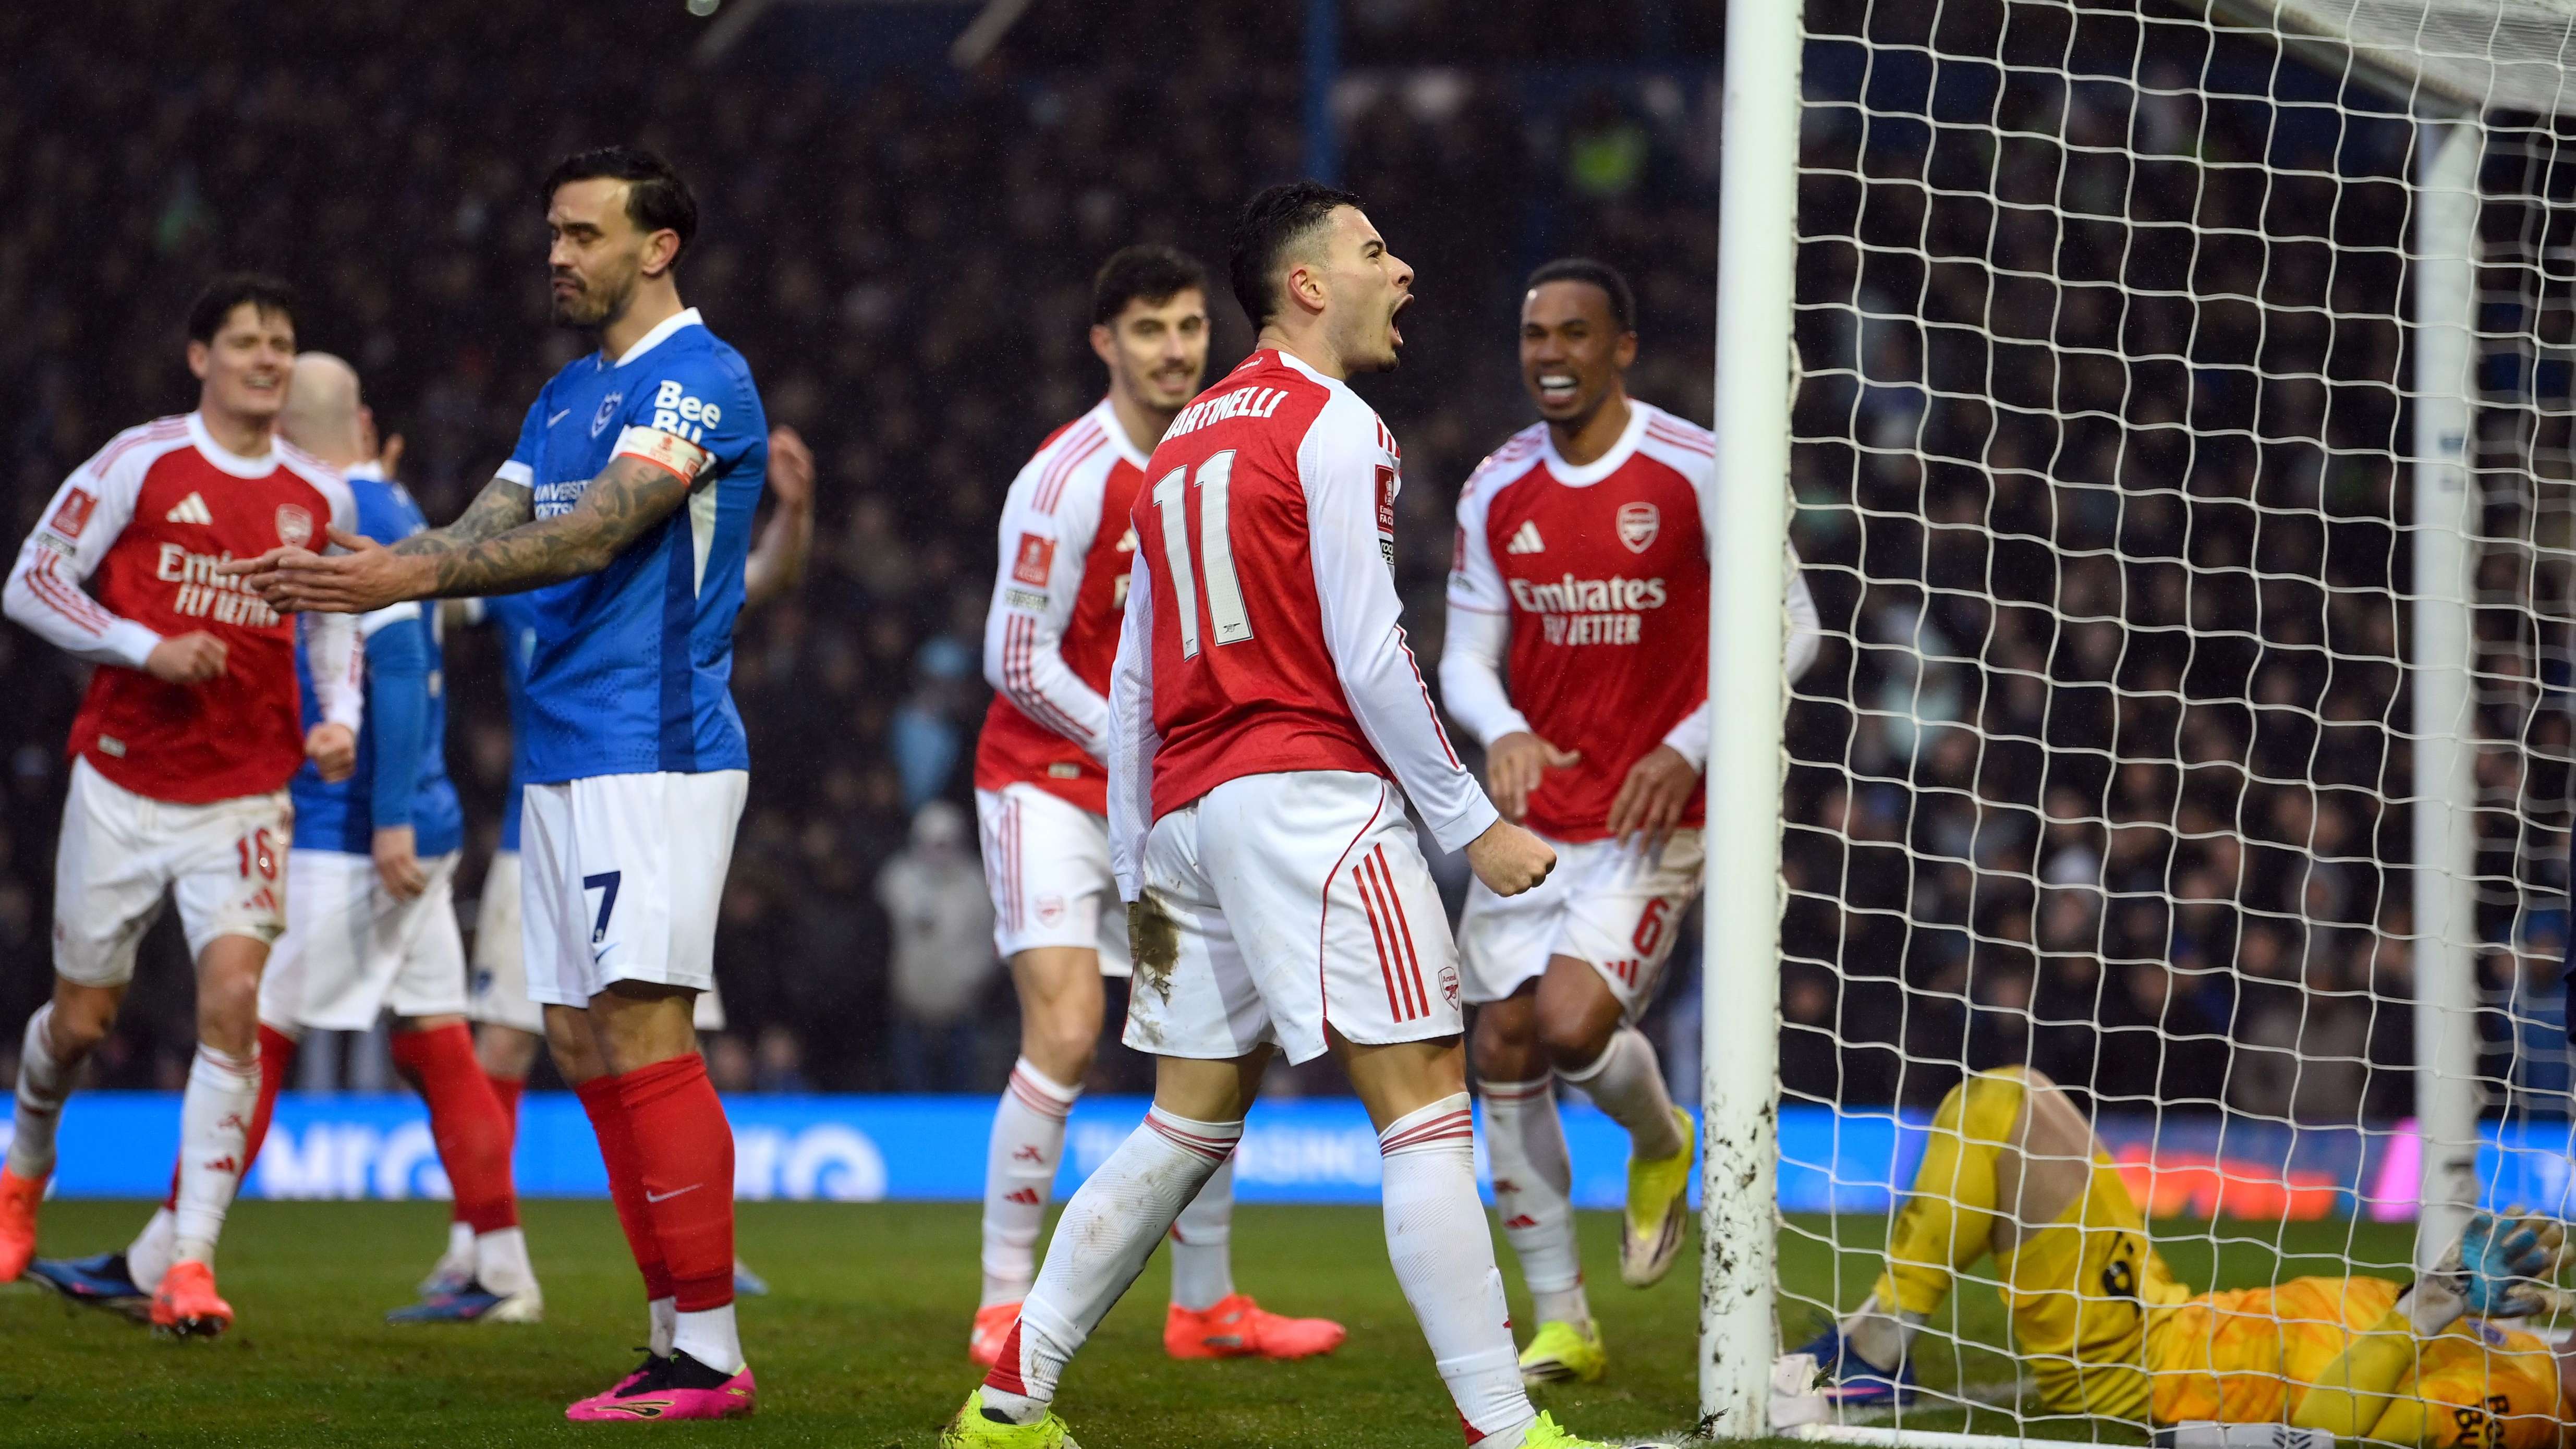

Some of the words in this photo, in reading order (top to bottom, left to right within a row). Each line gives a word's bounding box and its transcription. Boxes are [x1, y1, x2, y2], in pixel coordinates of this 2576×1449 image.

[654, 380, 721, 430] Bee
[1158, 386, 1289, 446] ARTINELLI
[1380, 514, 1388, 524] FA
[1152, 449, 1254, 662] 11
[1509, 572, 1667, 613] Emirates
[237, 827, 277, 882] 16
[584, 871, 621, 943] 7
[1632, 896, 1670, 957] 6
